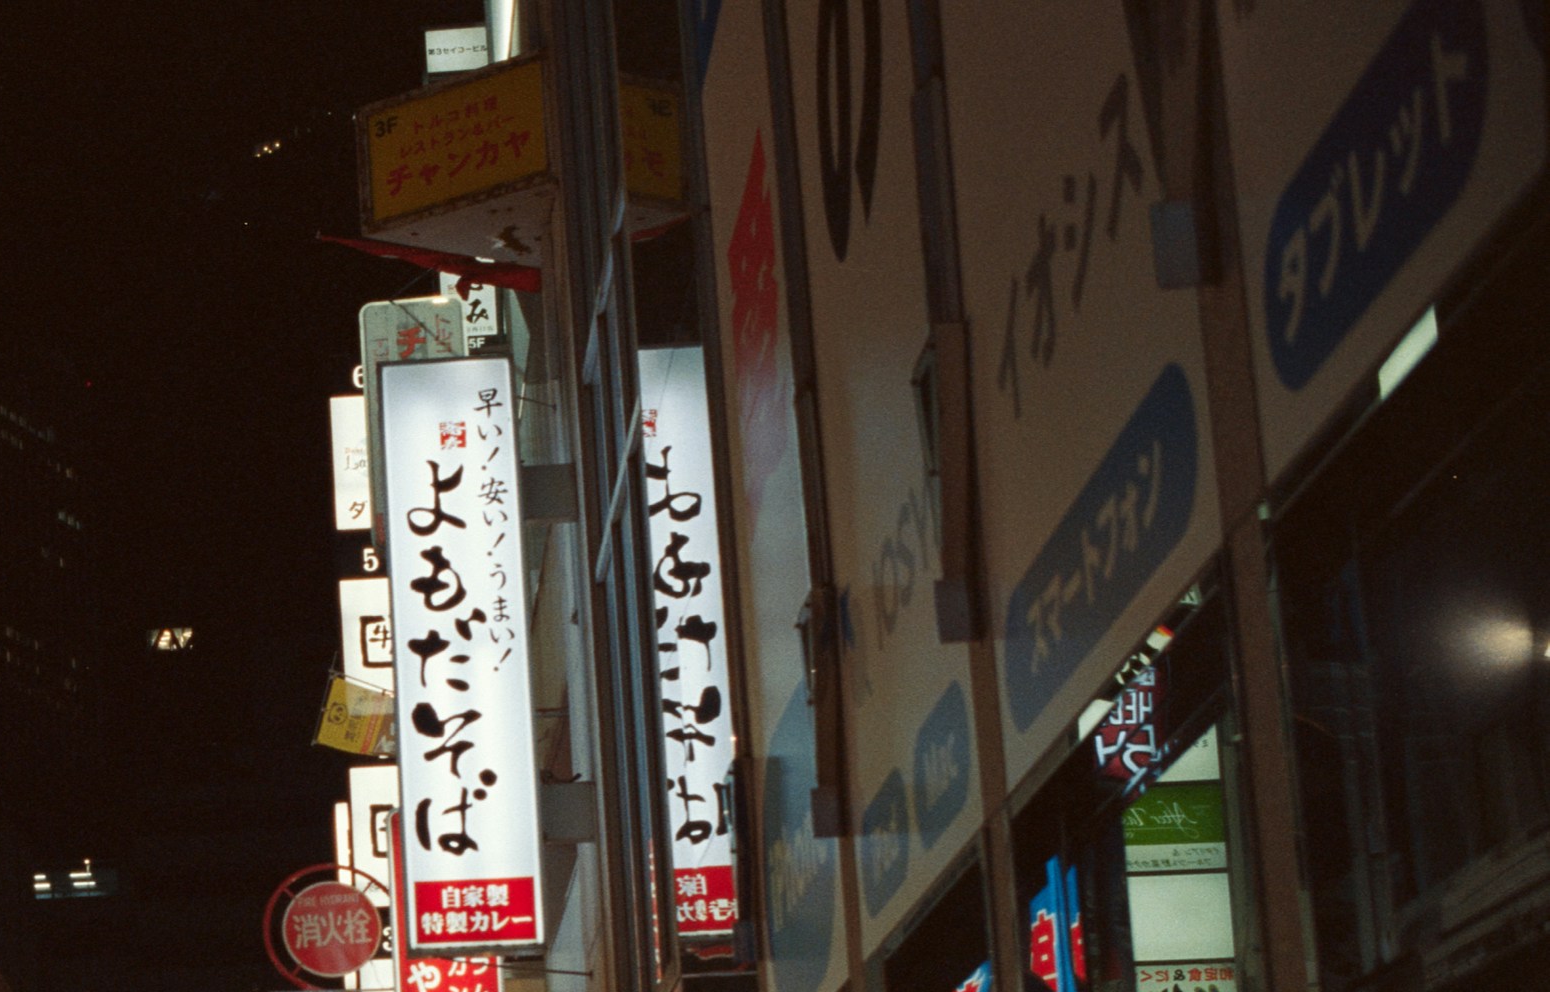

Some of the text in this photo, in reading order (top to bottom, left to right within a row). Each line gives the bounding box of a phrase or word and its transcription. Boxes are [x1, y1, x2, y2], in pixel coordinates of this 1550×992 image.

[374, 116, 398, 138] 3F
[412, 95, 498, 135] トルコ料理
[385, 130, 531, 198] チャンカヤ
[1278, 33, 1469, 347] タブレット
[998, 73, 1144, 419] イオシス
[468, 338, 485, 349] 5F
[362, 547, 379, 572] 5
[405, 459, 497, 856] よもだそば
[441, 885, 509, 910] 自家製
[293, 908, 373, 949] 消火栓
[421, 912, 533, 937] 特製カレー
